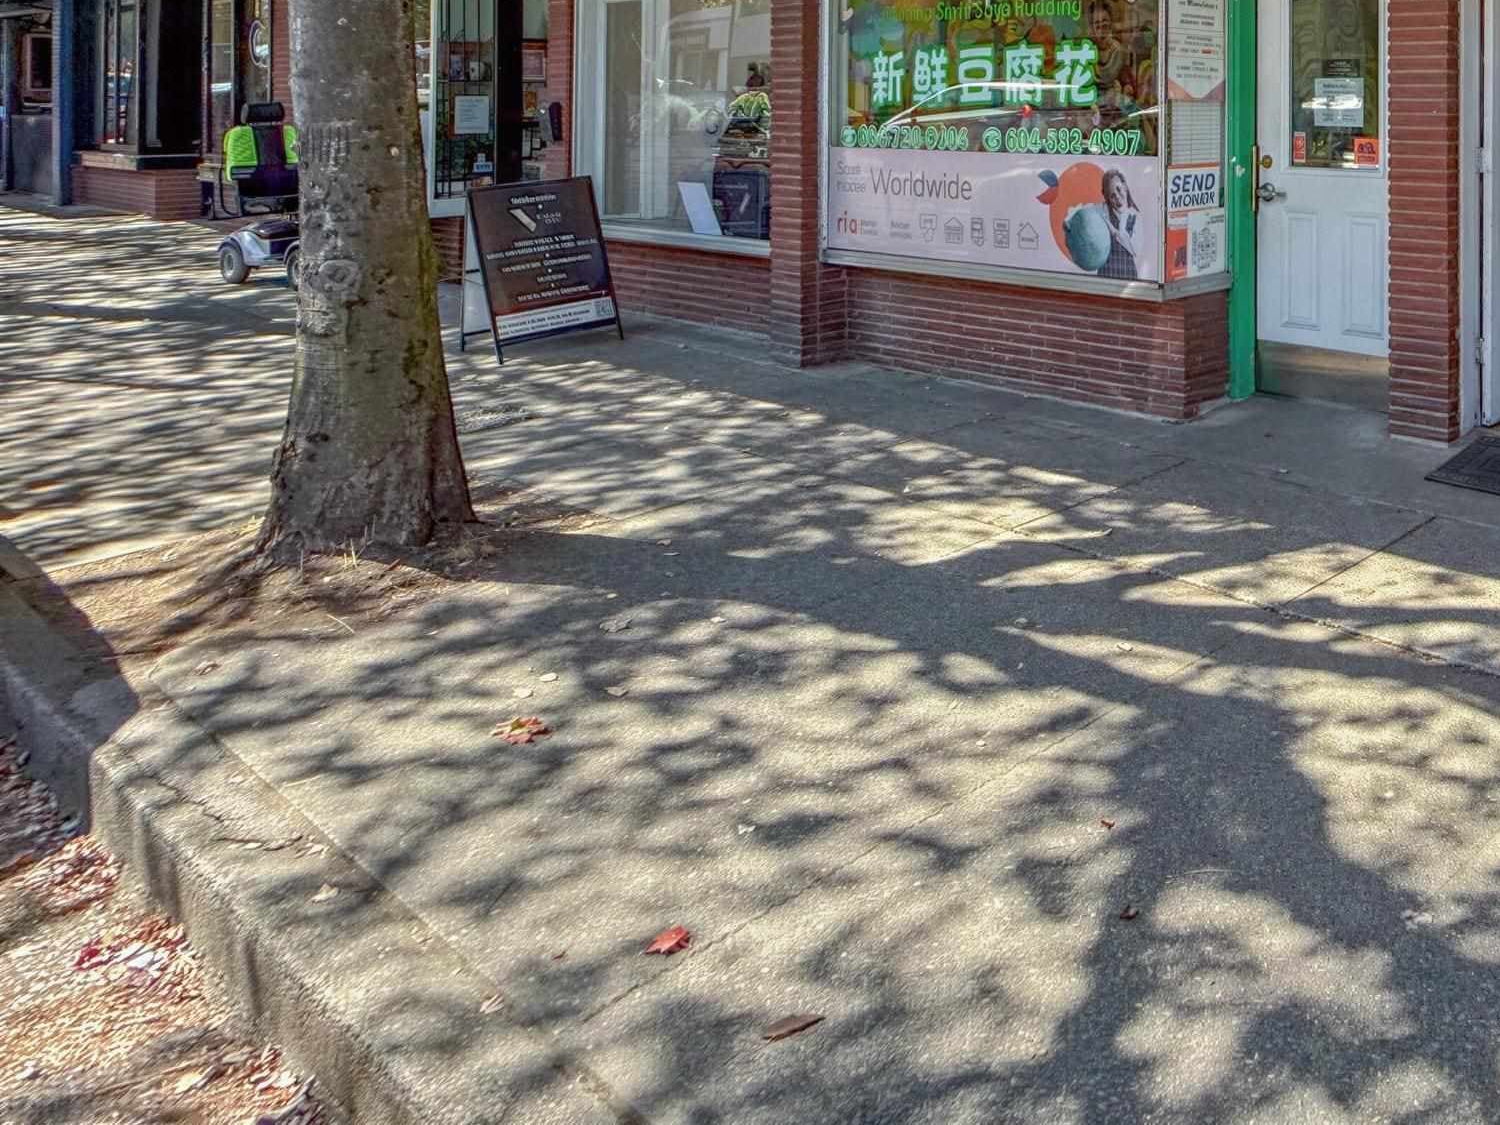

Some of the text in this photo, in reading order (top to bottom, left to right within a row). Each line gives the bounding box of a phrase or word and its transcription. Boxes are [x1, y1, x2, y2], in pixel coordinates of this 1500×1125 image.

[869, 167, 973, 200] Worldwide
[1171, 173, 1216, 194] SEND
[836, 210, 858, 235] ria
